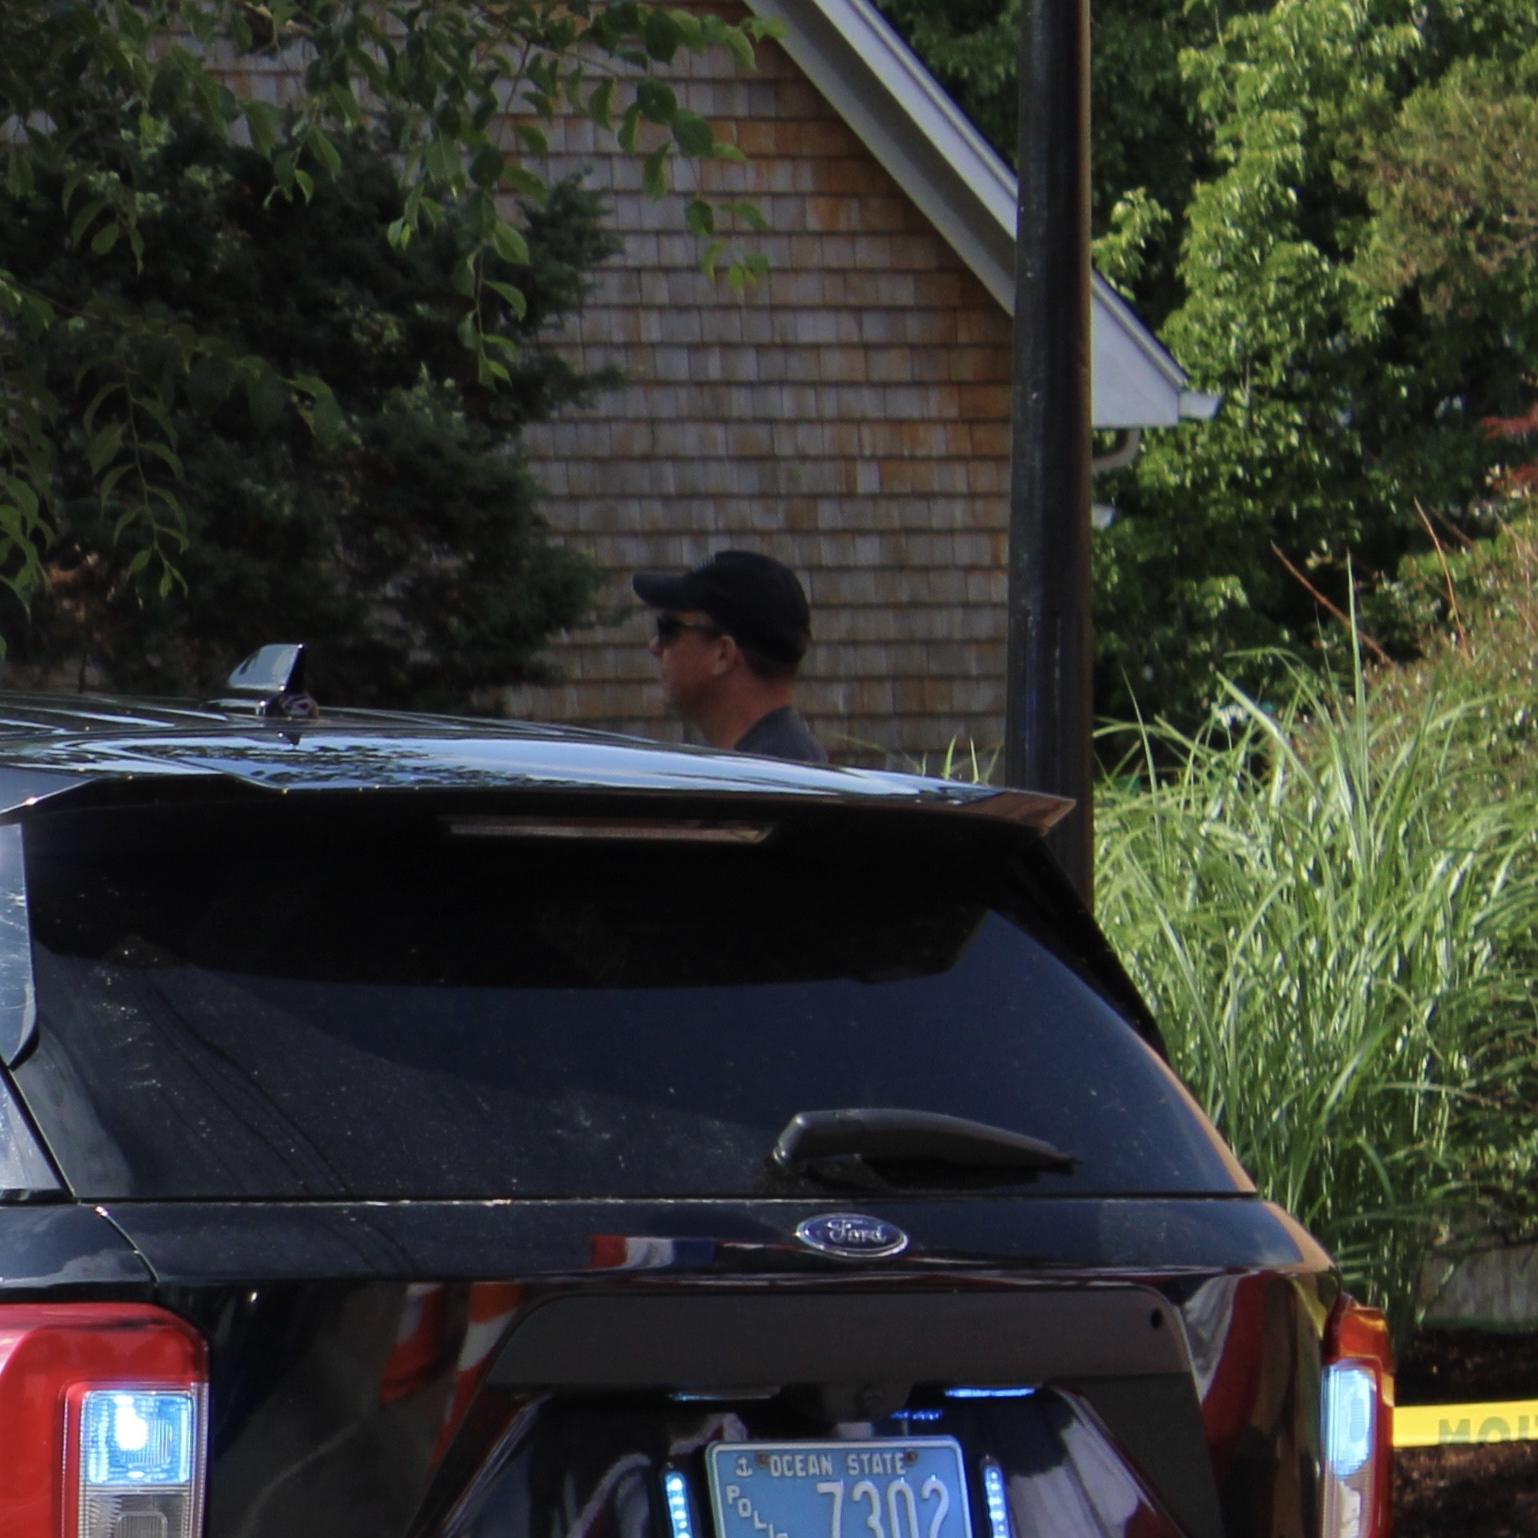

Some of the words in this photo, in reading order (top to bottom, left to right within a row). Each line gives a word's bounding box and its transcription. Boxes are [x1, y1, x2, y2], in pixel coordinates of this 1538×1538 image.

[826, 1219, 887, 1244] Ford
[769, 1454, 833, 1477] OCEAN
[847, 1452, 907, 1475] STATE
